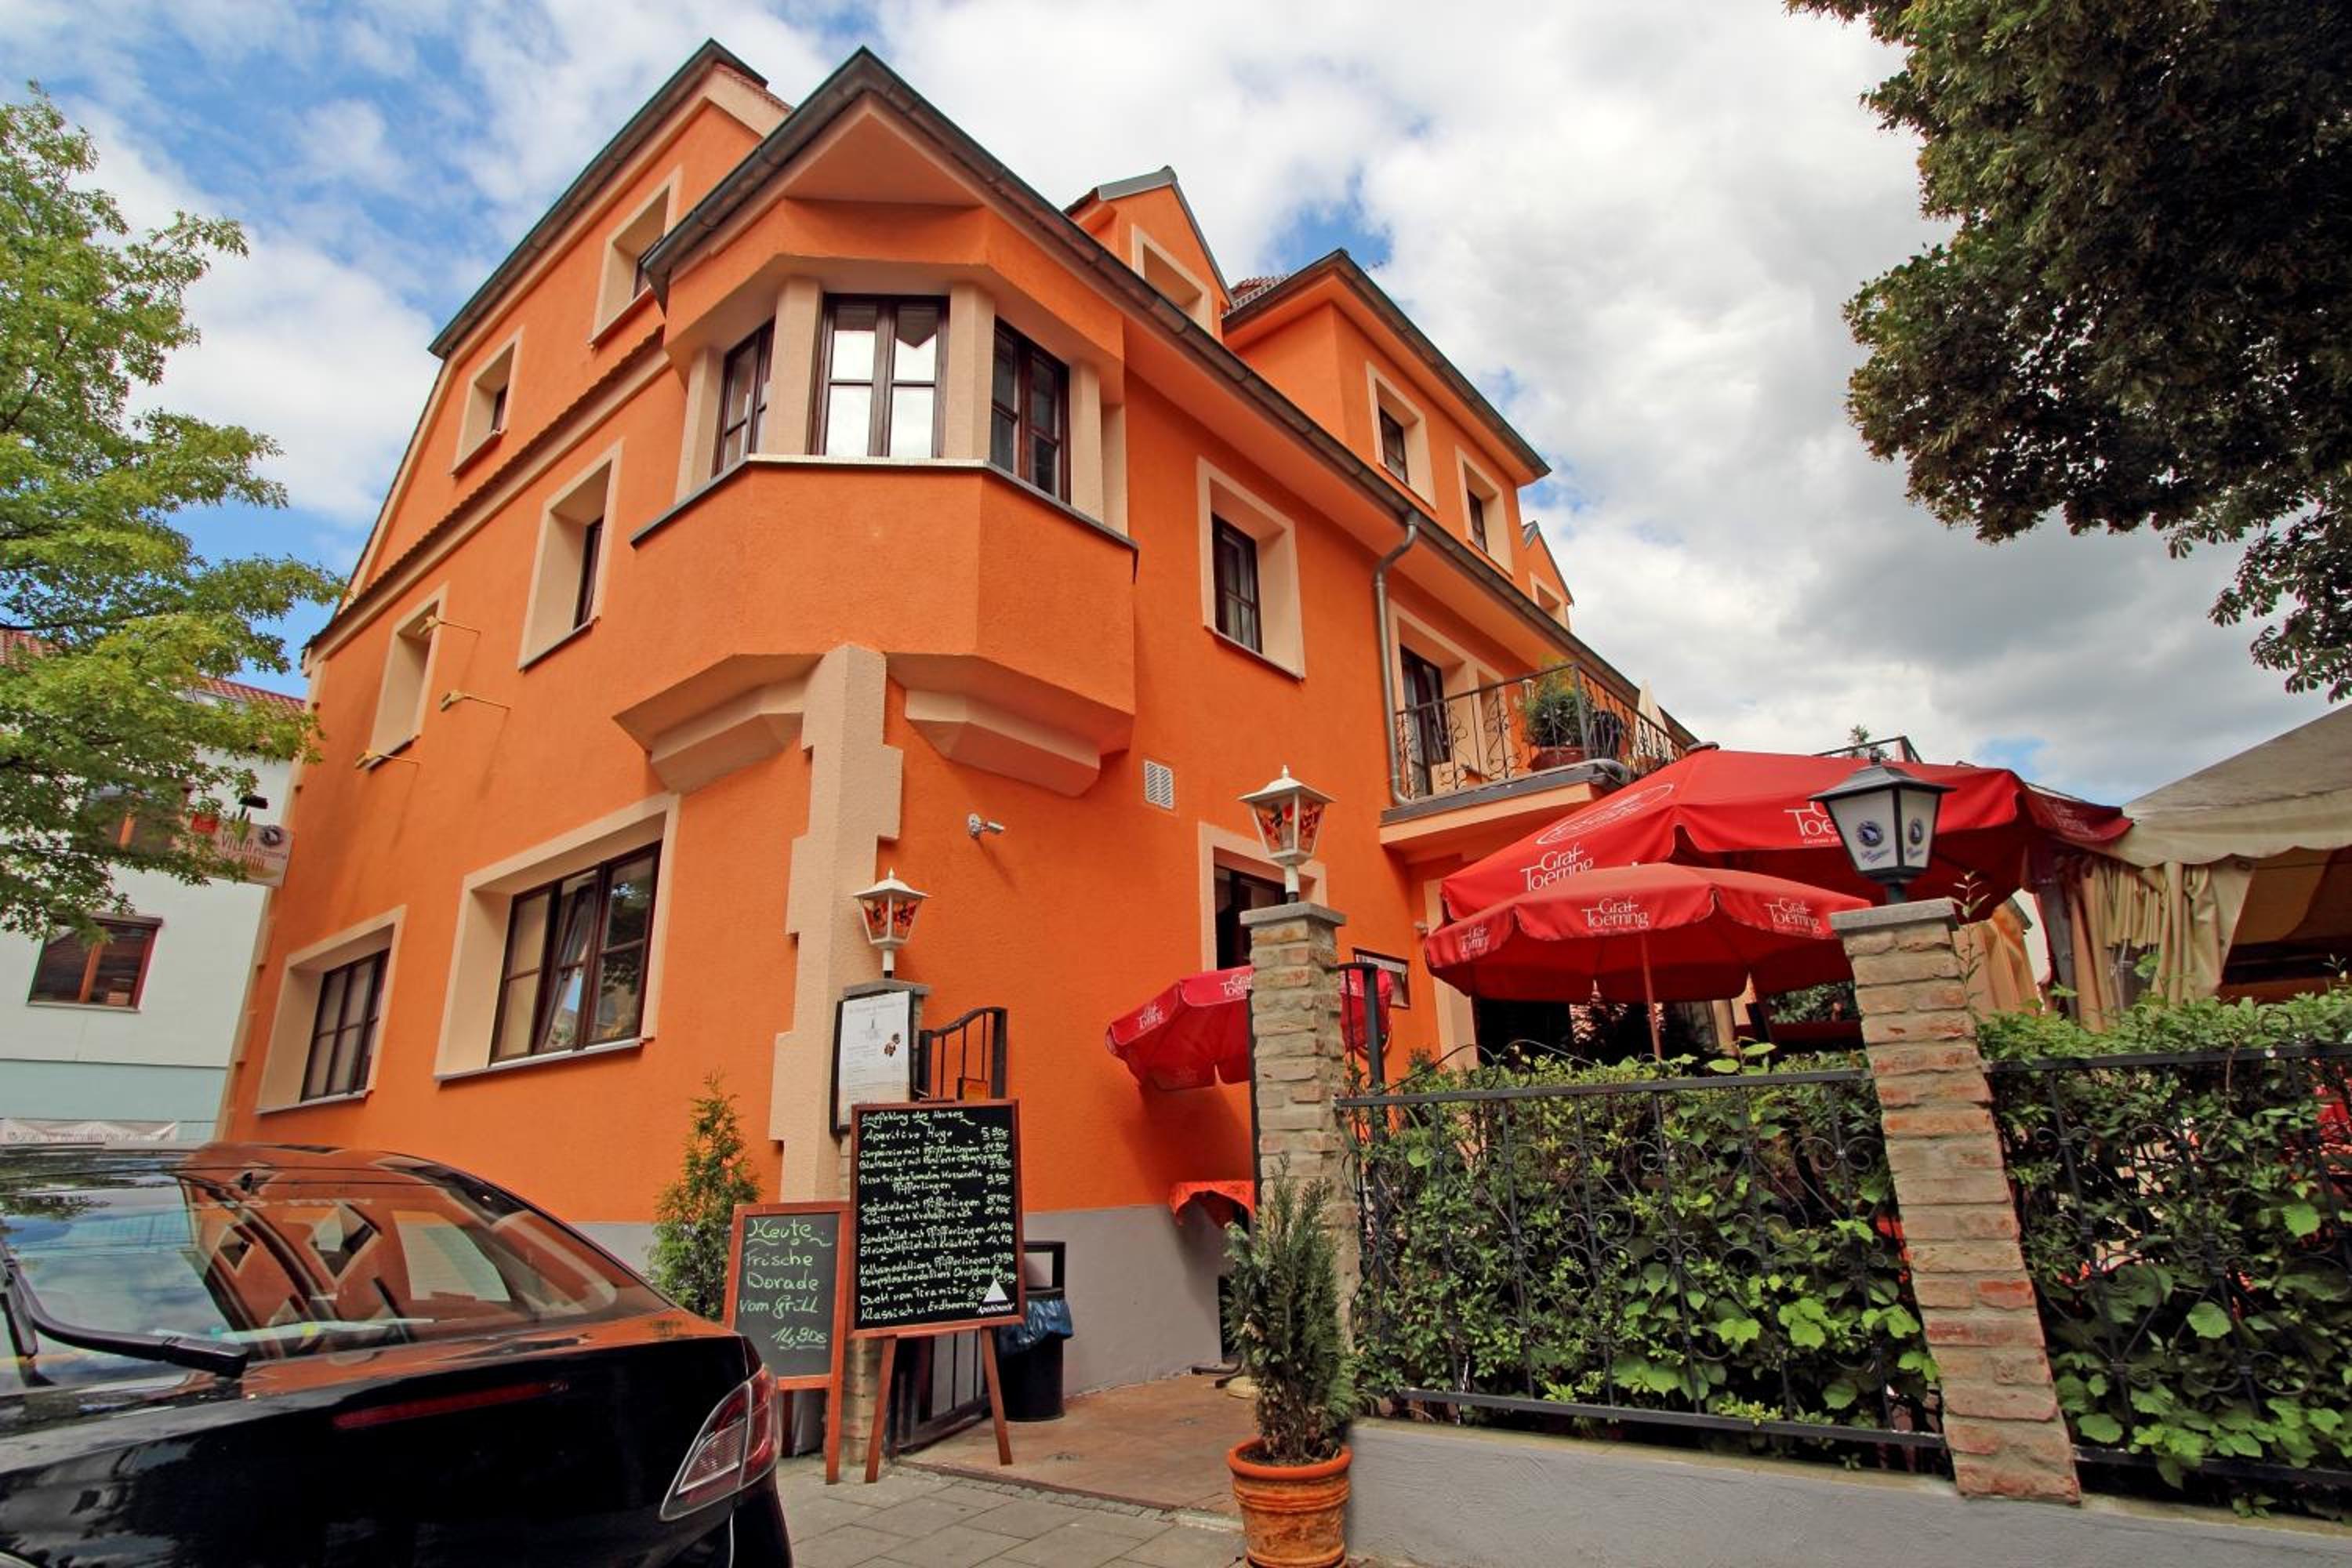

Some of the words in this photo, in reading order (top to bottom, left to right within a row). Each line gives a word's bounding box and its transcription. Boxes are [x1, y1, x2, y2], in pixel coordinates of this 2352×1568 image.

[1540, 842, 1584, 872] Graf
[1599, 895, 1639, 914] Graf
[1581, 908, 1649, 929] Toerring
[927, 1127, 953, 1144] Hugo
[904, 1147, 920, 1156] mit
[908, 1156, 920, 1166] mit
[906, 1201, 920, 1210] mit
[895, 1213, 910, 1222] mit
[746, 1218, 812, 1238] Heute
[910, 1229, 924, 1238] mit
[924, 1240, 937, 1249] mit
[744, 1248, 813, 1266] Frische
[746, 1269, 818, 1291] Dorade
